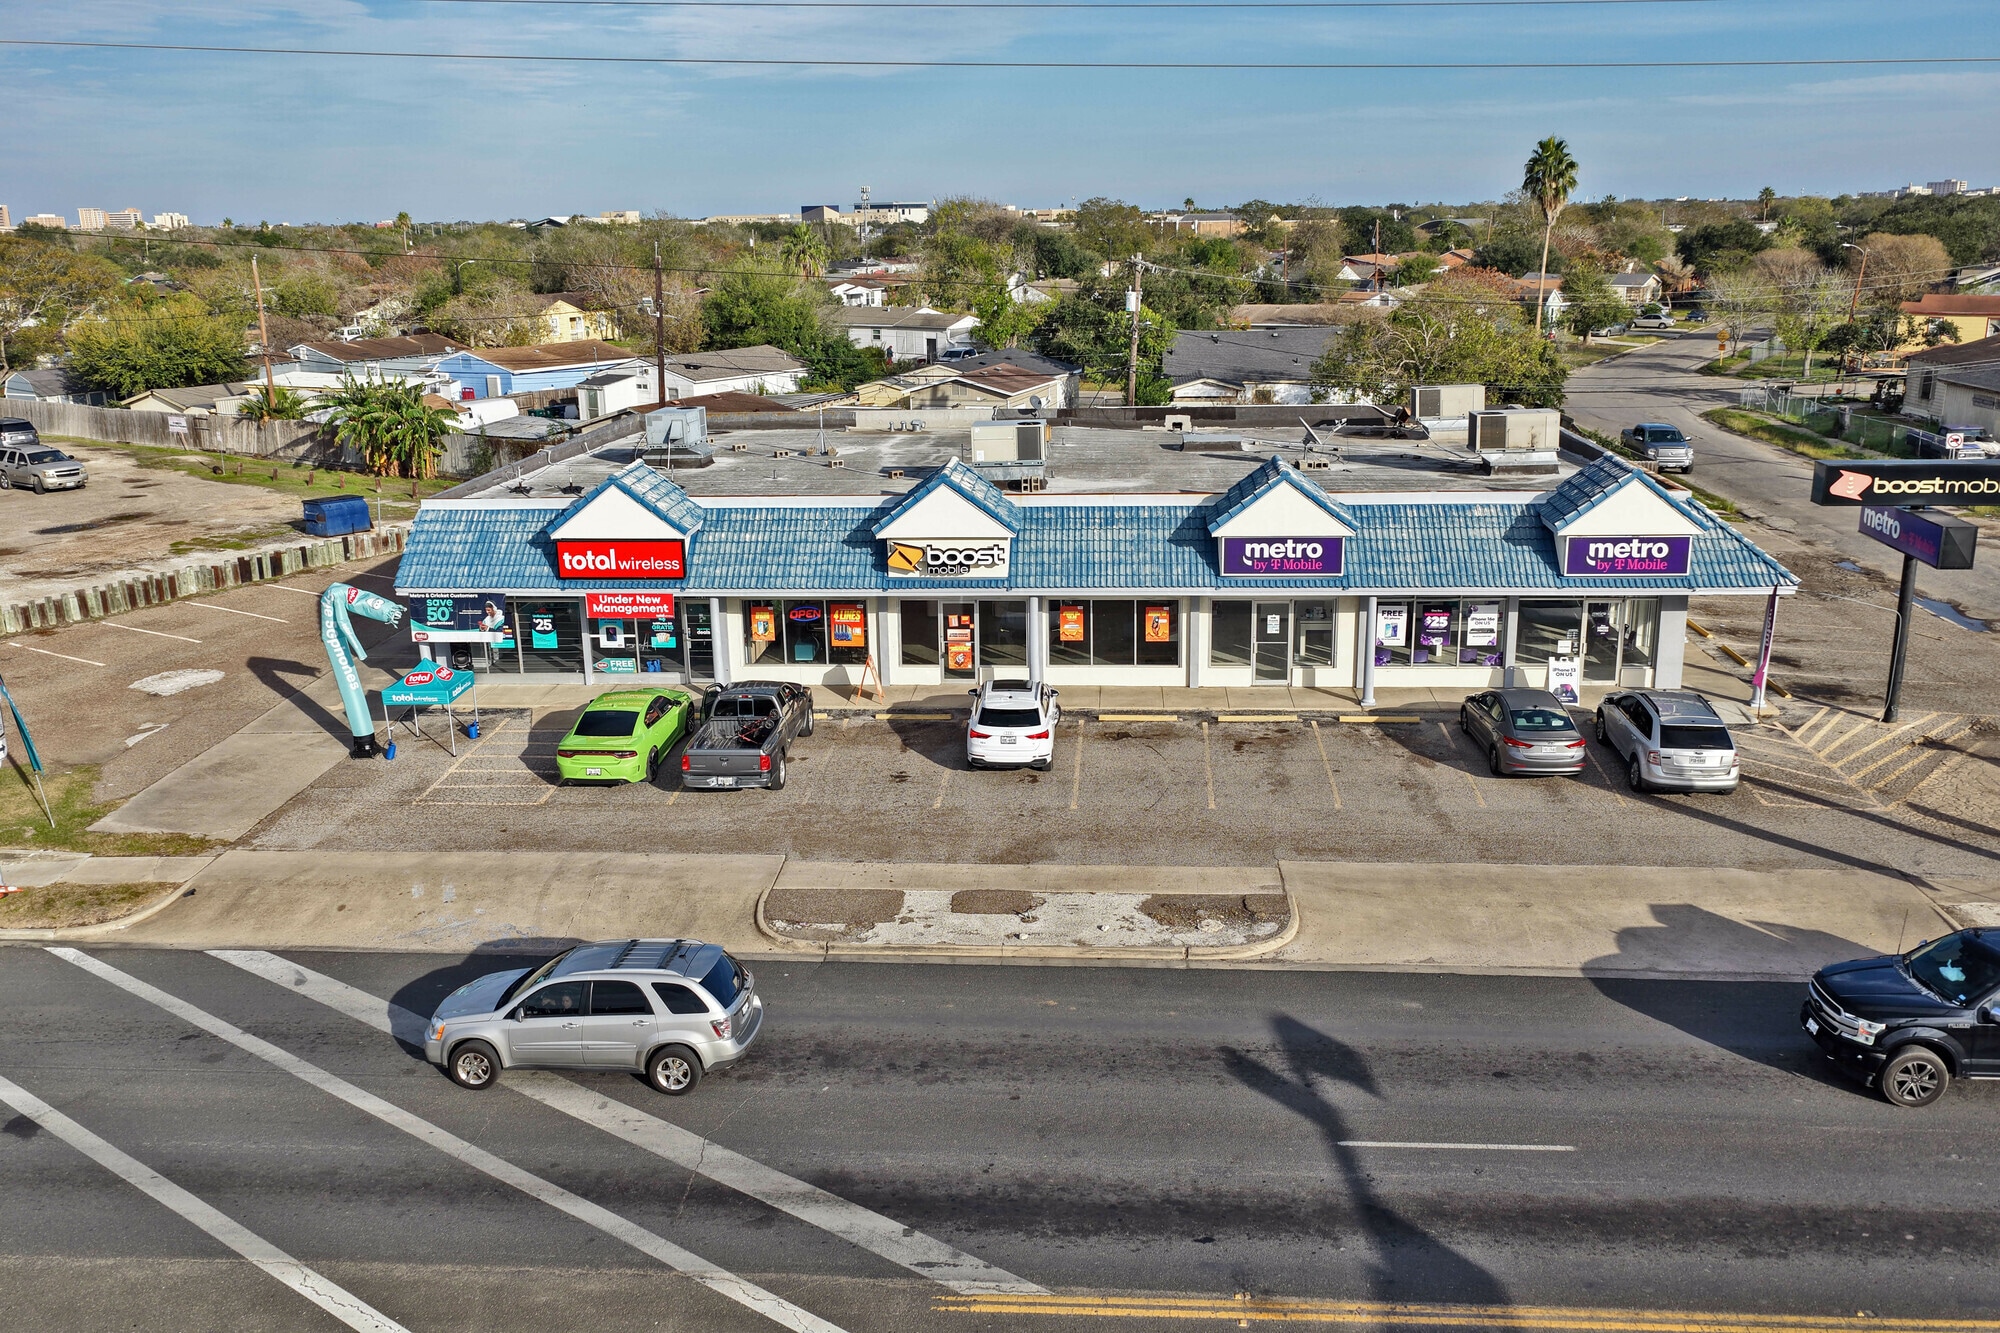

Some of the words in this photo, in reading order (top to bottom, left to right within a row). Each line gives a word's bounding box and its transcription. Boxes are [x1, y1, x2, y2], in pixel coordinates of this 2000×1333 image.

[1863, 507, 1901, 539] metro
[1245, 539, 1323, 558] metro
[1589, 539, 1669, 559] metro
[562, 548, 617, 570] total
[618, 557, 680, 570] wireless
[927, 544, 1005, 565] boost
[928, 565, 969, 574] mobile
[1254, 559, 1268, 572] by
[1283, 559, 1323, 570] Mobile
[1597, 559, 1612, 573] by
[1627, 559, 1668, 570] Mobile
[599, 595, 634, 604] Under
[636, 595, 661, 604] New
[593, 604, 669, 614] Management
[789, 610, 821, 619] OPEN
[834, 610, 840, 620] 4
[840, 610, 861, 620] LINES
[1424, 616, 1448, 626] $25
[409, 674, 430, 682] total
[392, 693, 413, 702] total
